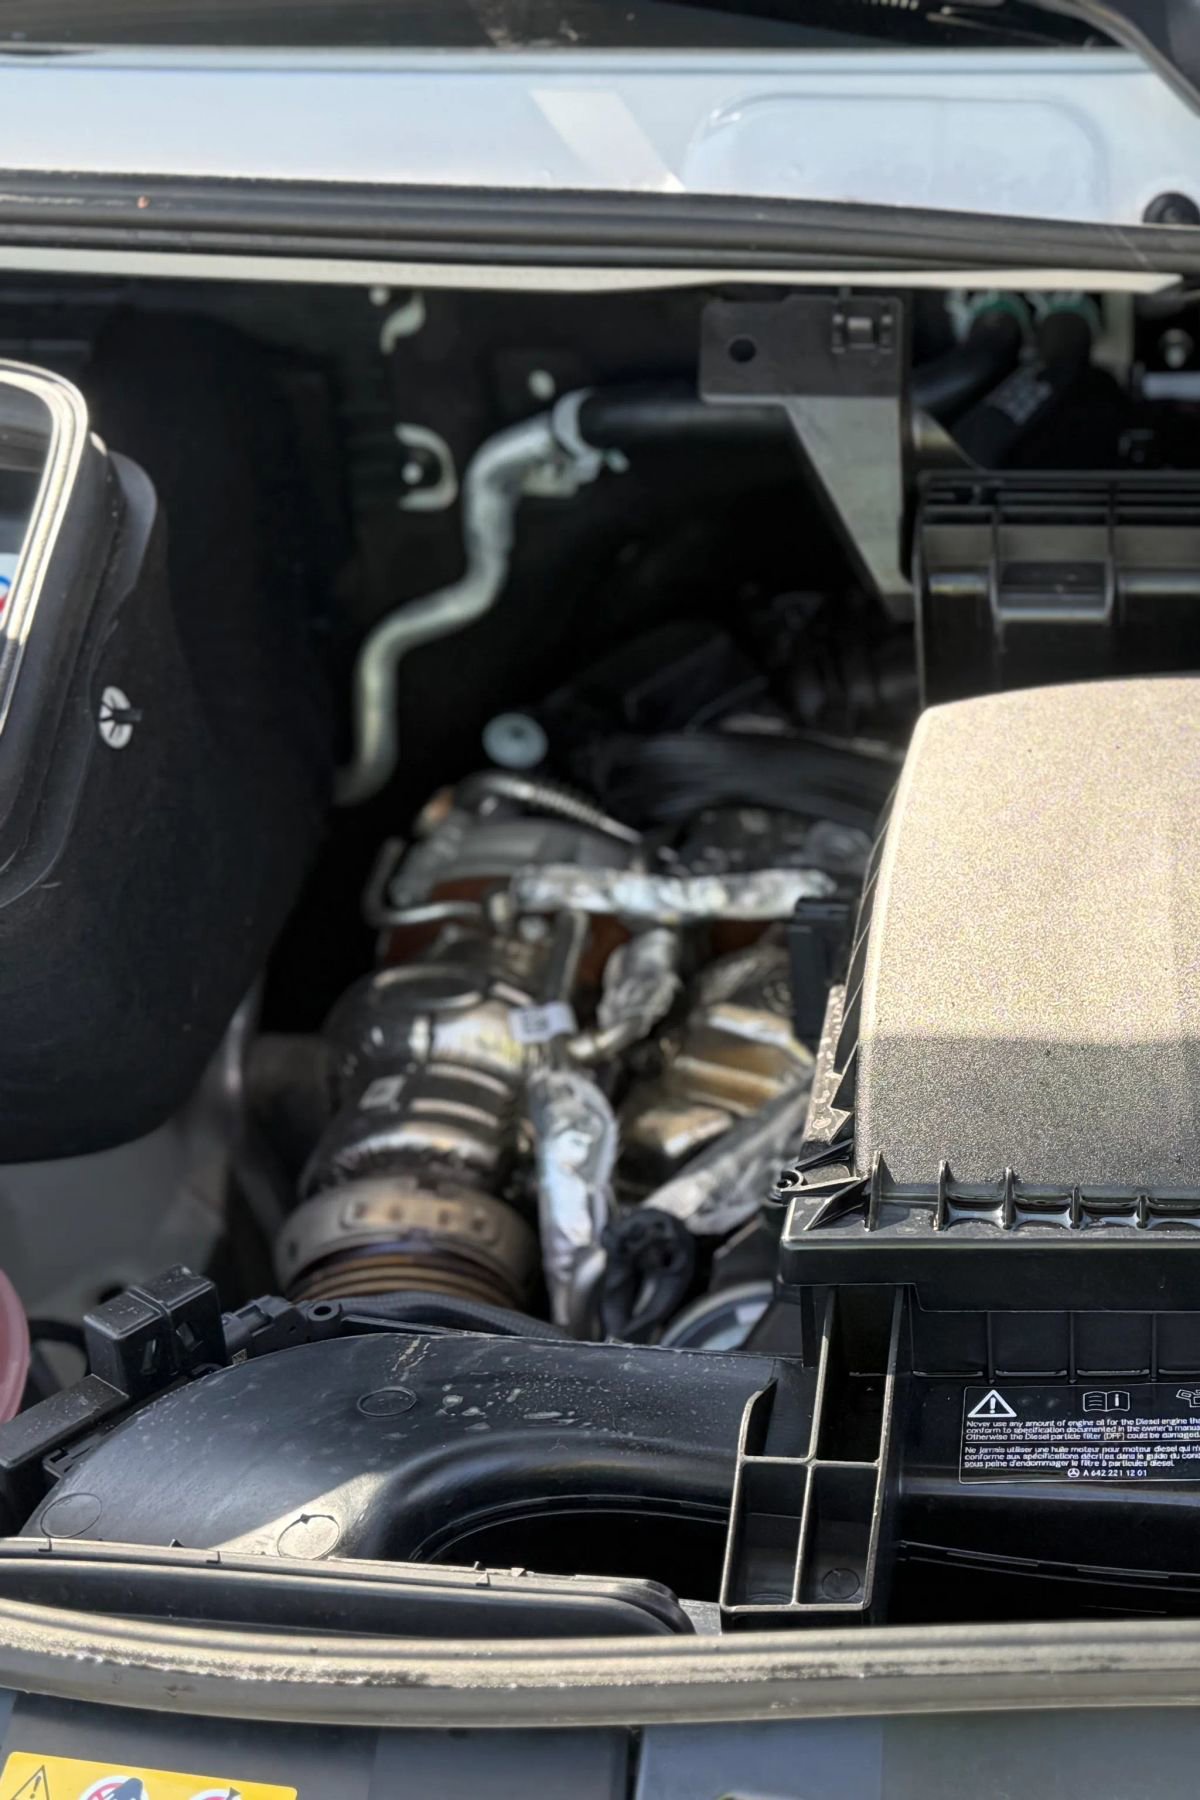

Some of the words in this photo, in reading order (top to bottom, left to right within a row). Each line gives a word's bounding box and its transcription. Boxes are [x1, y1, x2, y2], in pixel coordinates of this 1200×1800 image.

[1009, 1421, 1022, 1429] any
[1067, 1419, 1093, 1428] engine
[1106, 1418, 1118, 1426] for
[1120, 1418, 1134, 1426] the
[1083, 1469, 1088, 1477] A
[1126, 1469, 1134, 1477] 12
[1137, 1469, 1146, 1477] 01
